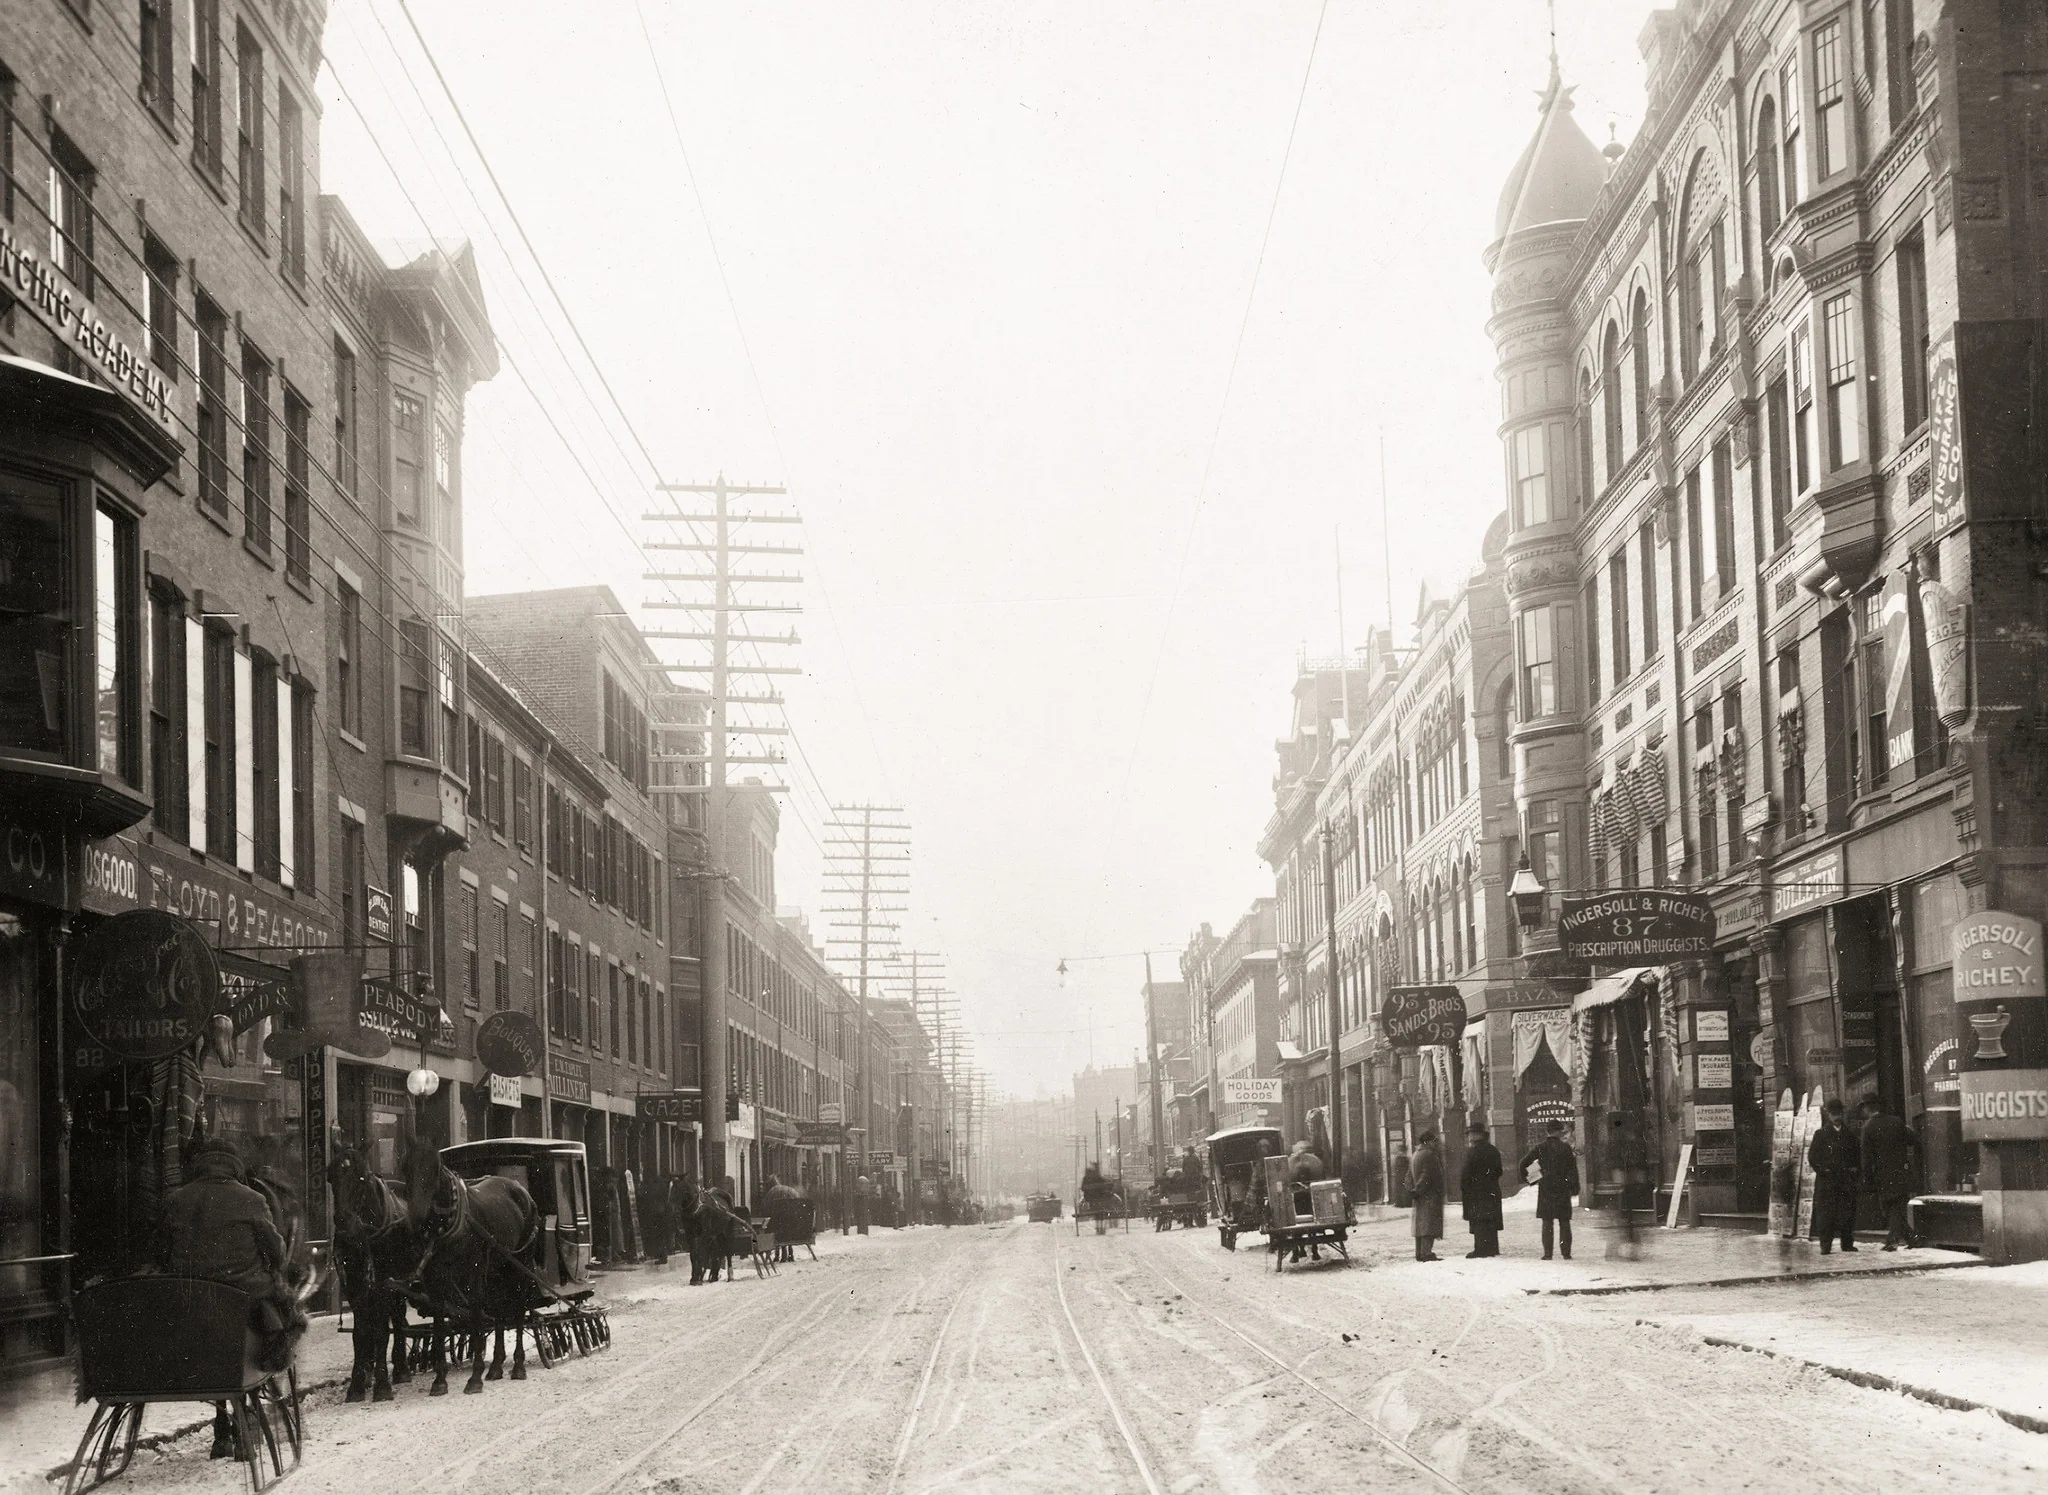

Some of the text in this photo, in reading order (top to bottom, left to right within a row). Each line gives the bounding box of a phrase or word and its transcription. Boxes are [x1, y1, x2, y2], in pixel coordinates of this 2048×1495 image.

[78, 306, 173, 422] ACADEMY
[1932, 375, 1947, 443] LIFE
[1934, 367, 1958, 505] INSURANCE
[1889, 729, 1914, 770] BANK
[1798, 863, 1812, 876] THE
[149, 864, 329, 956] FLOYD & PEABODY
[1562, 898, 1637, 931] INGERSOLL
[1642, 897, 1653, 911] &
[369, 916, 390, 934] DENTIST
[1612, 915, 1660, 937] 87
[1568, 939, 1642, 958] PRESCRIPTION
[1982, 948, 1994, 961] &
[275, 986, 292, 1008] &
[1388, 1008, 1428, 1040] SANDS
[1427, 1022, 1456, 1041] 95
[486, 1017, 535, 1068] BOUQUET
[1923, 1038, 1955, 1074] INGERSOLL
[1227, 1081, 1278, 1091] HOLIDAY
[1934, 1079, 1961, 1092] PHARMAC
